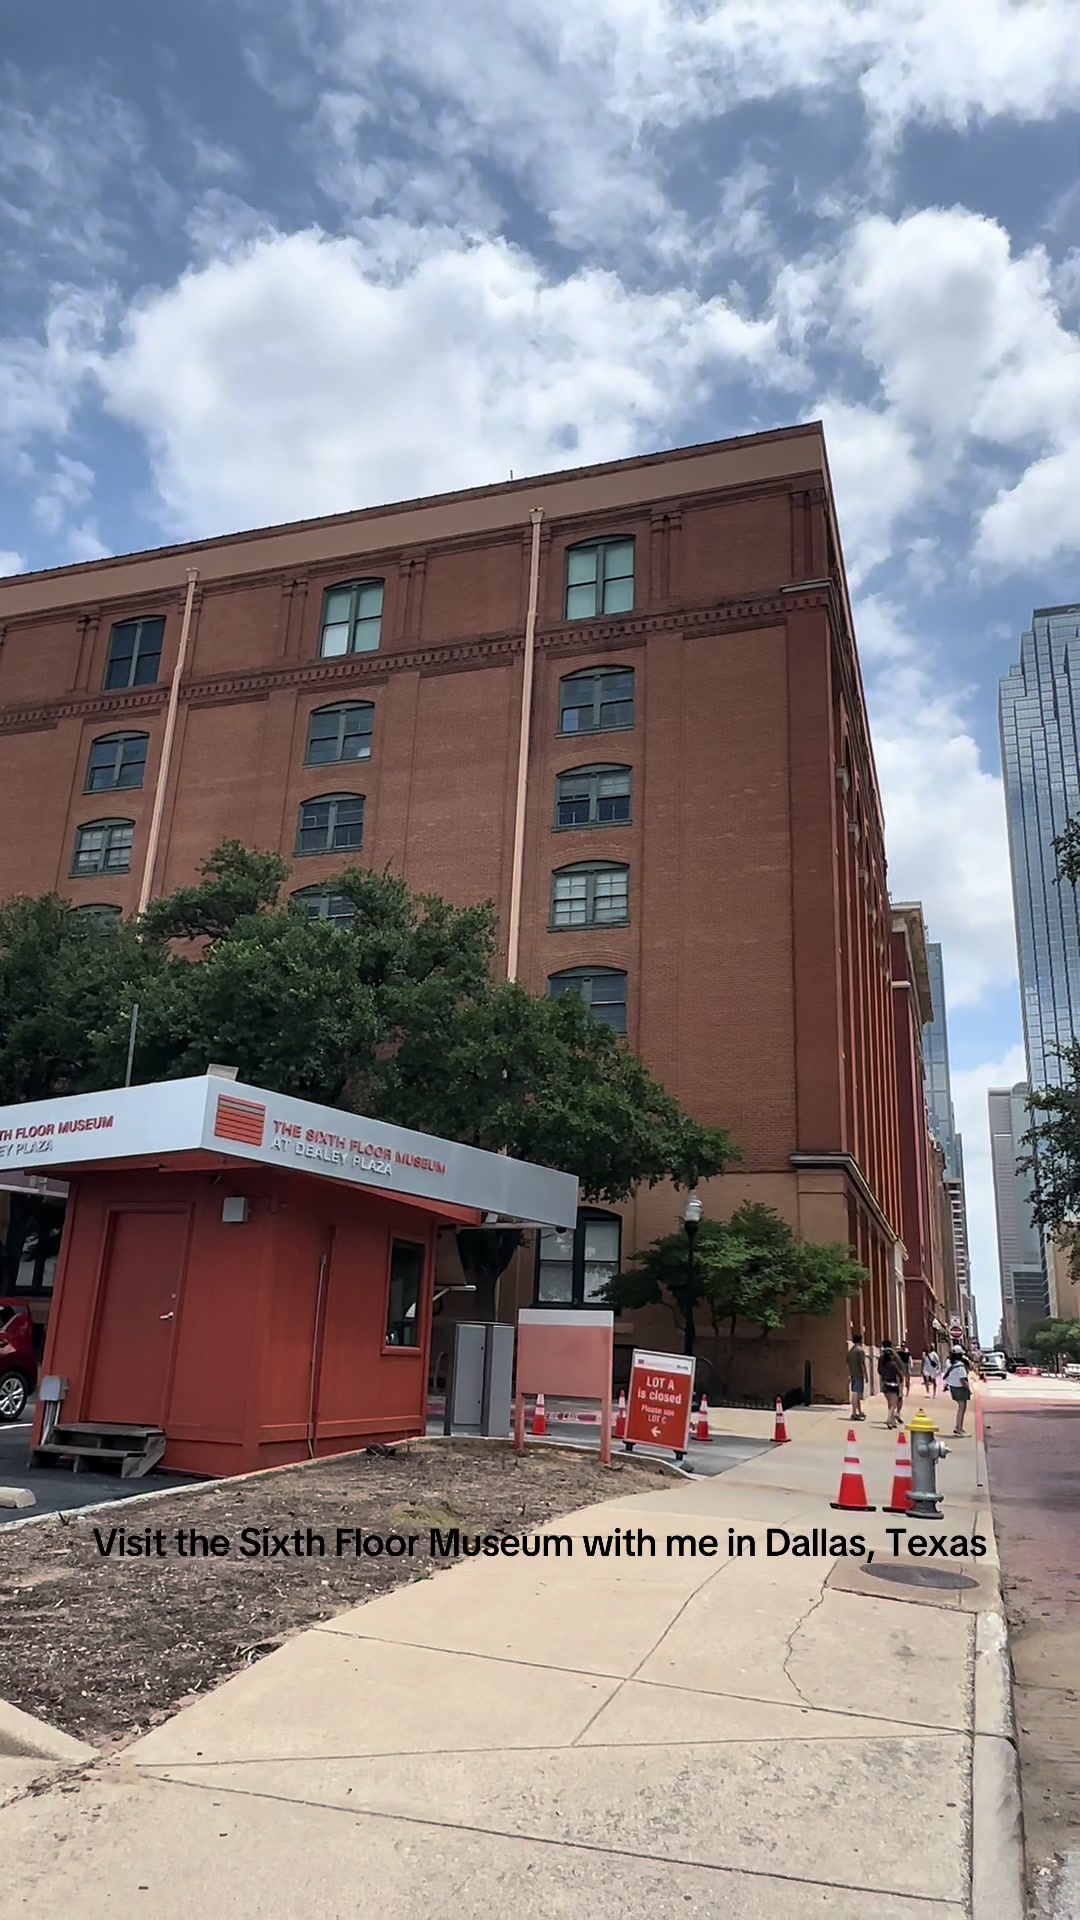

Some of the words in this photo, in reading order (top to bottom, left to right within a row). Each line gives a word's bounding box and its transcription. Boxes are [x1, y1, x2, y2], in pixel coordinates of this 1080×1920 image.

[15, 1123, 55, 1139] FLOOR
[57, 1115, 115, 1134] MUSEUM
[16, 1139, 53, 1156] PLAZA
[273, 1120, 302, 1138] THE
[305, 1129, 346, 1149] SIXTH
[350, 1139, 392, 1161] FLOOR
[395, 1151, 447, 1175] MUSEUM
[271, 1138, 290, 1152] AT
[295, 1142, 347, 1166] DEALEY
[352, 1155, 392, 1176] PLAZA
[646, 1376, 666, 1388] LOT
[667, 1379, 675, 1390] A
[649, 1390, 682, 1404] closed
[647, 1414, 660, 1423] LOT
[661, 1416, 667, 1424] C
